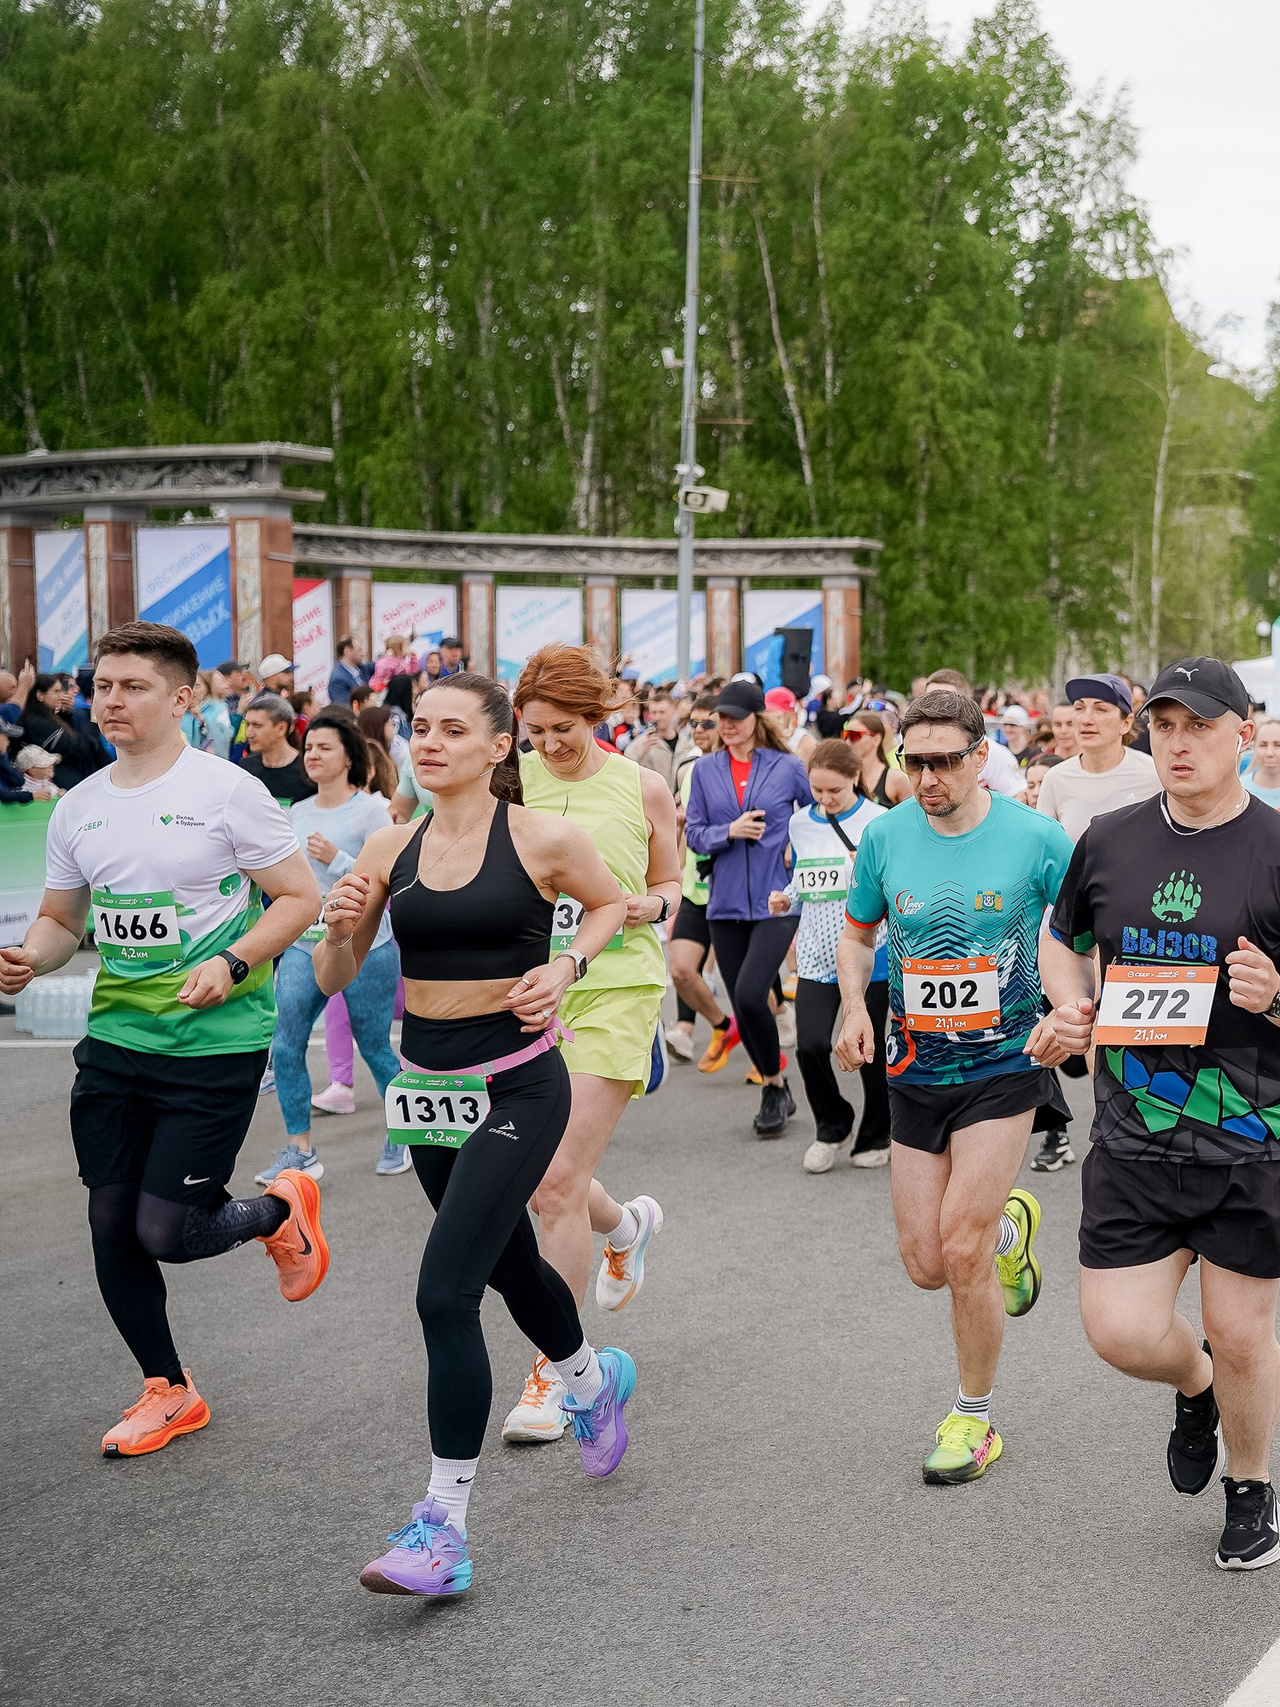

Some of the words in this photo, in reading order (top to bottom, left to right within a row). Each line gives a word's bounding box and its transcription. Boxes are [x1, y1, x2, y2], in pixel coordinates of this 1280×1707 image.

[799, 870, 839, 889] 1399
[100, 912, 168, 940] 1666
[1122, 926, 1218, 963] ВЫЗОВ
[920, 980, 979, 1008] 202
[1122, 989, 1190, 1020] 272
[396, 1095, 479, 1124] 1313
